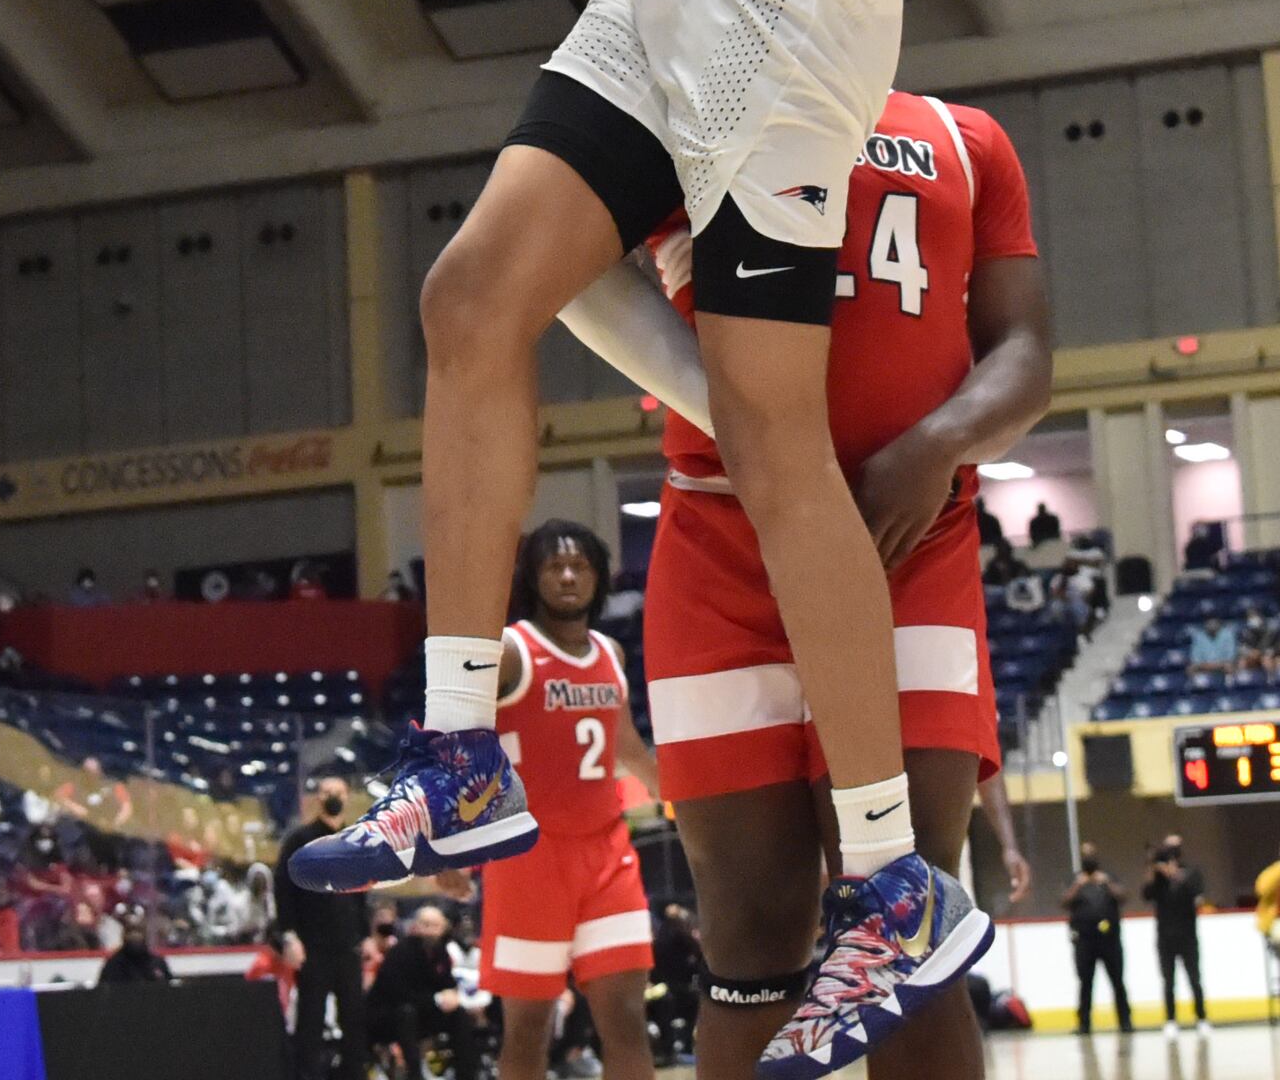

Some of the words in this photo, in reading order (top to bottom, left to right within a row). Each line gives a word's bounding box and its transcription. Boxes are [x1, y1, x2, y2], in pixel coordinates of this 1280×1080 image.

[834, 191, 929, 317] 4
[61, 445, 242, 495] CONCESSIONS
[544, 678, 620, 711] MILTON
[575, 717, 606, 780] 2
[720, 987, 787, 1004] Mueller
